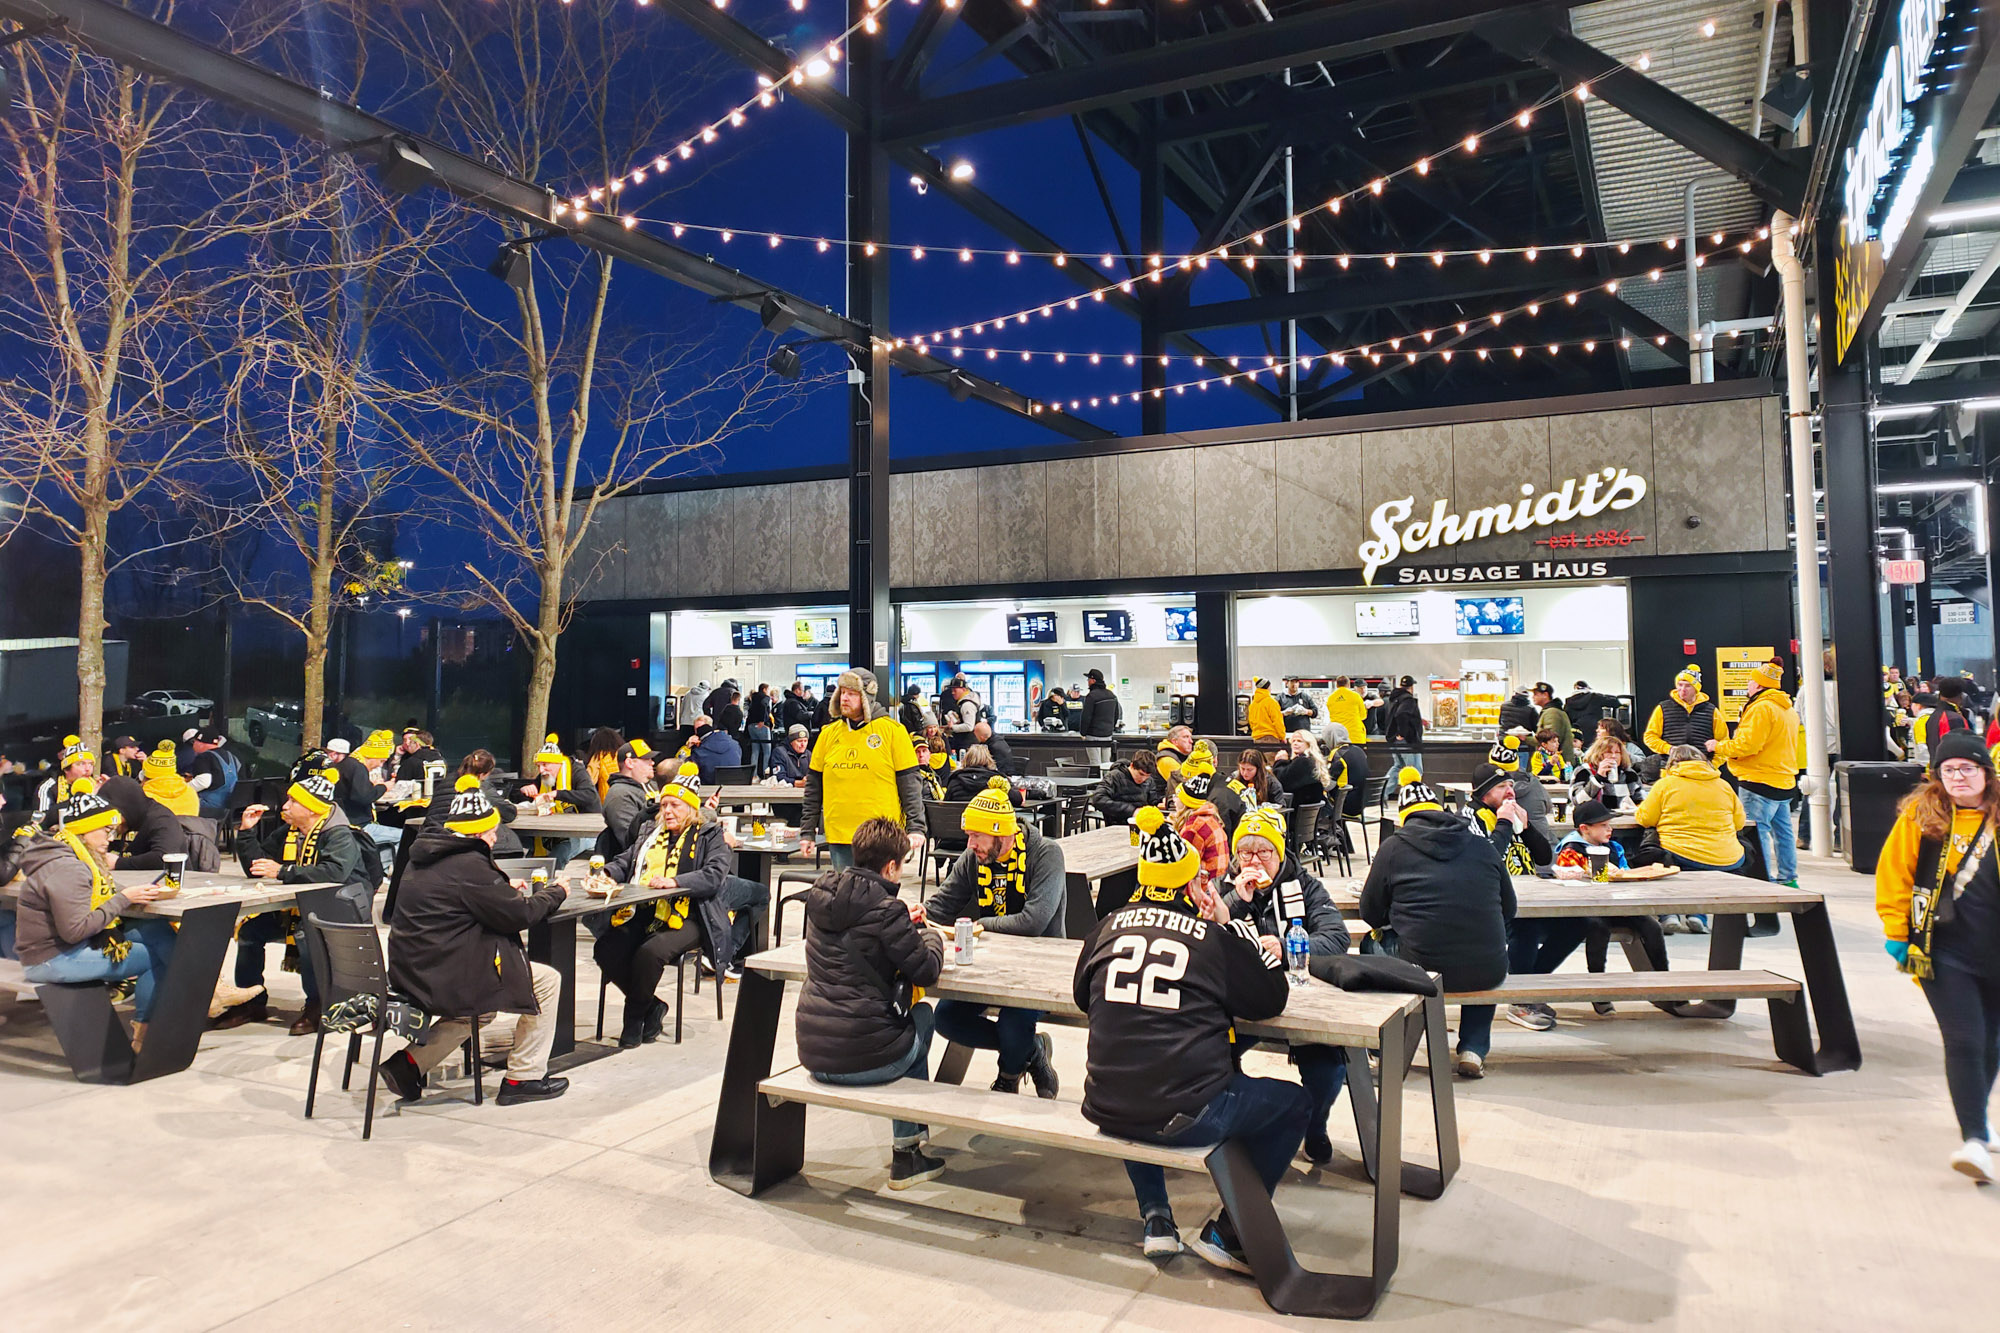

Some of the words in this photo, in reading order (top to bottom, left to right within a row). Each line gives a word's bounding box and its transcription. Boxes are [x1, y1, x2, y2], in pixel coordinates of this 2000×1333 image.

[1358, 466, 1647, 587] Schmidt's
[1549, 530, 1579, 549] est
[1585, 529, 1632, 548] 1886
[1892, 562, 1919, 580] EXIT
[831, 762, 870, 771] ACURA
[1111, 907, 1208, 941] PRESTHUS
[1105, 935, 1190, 1010] 22
